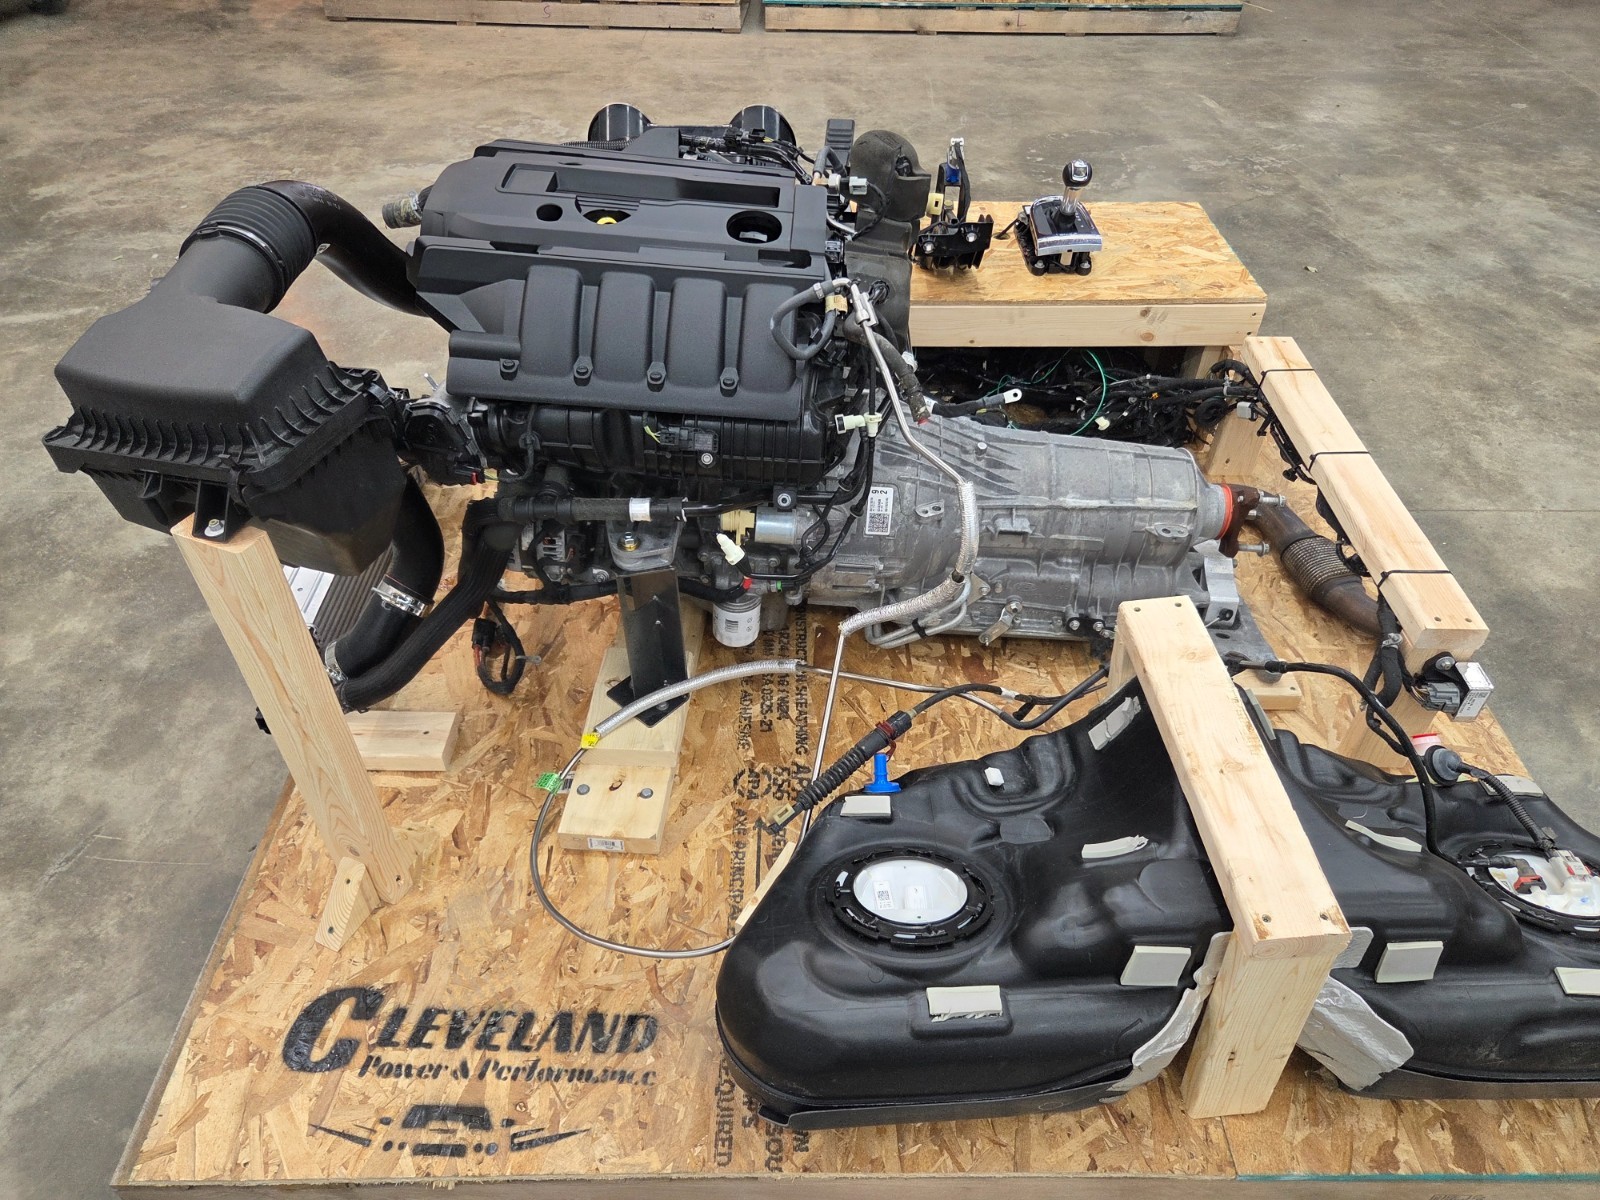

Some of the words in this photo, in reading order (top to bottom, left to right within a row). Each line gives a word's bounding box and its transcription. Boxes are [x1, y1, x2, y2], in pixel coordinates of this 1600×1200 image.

[737, 690, 752, 750] ADHESIVE
[796, 686, 808, 755] SHEATHING
[733, 809, 748, 835] AXE
[282, 986, 658, 1073] CLEVELAND
[358, 1055, 448, 1079] Power
[477, 1057, 657, 1086] Performance
